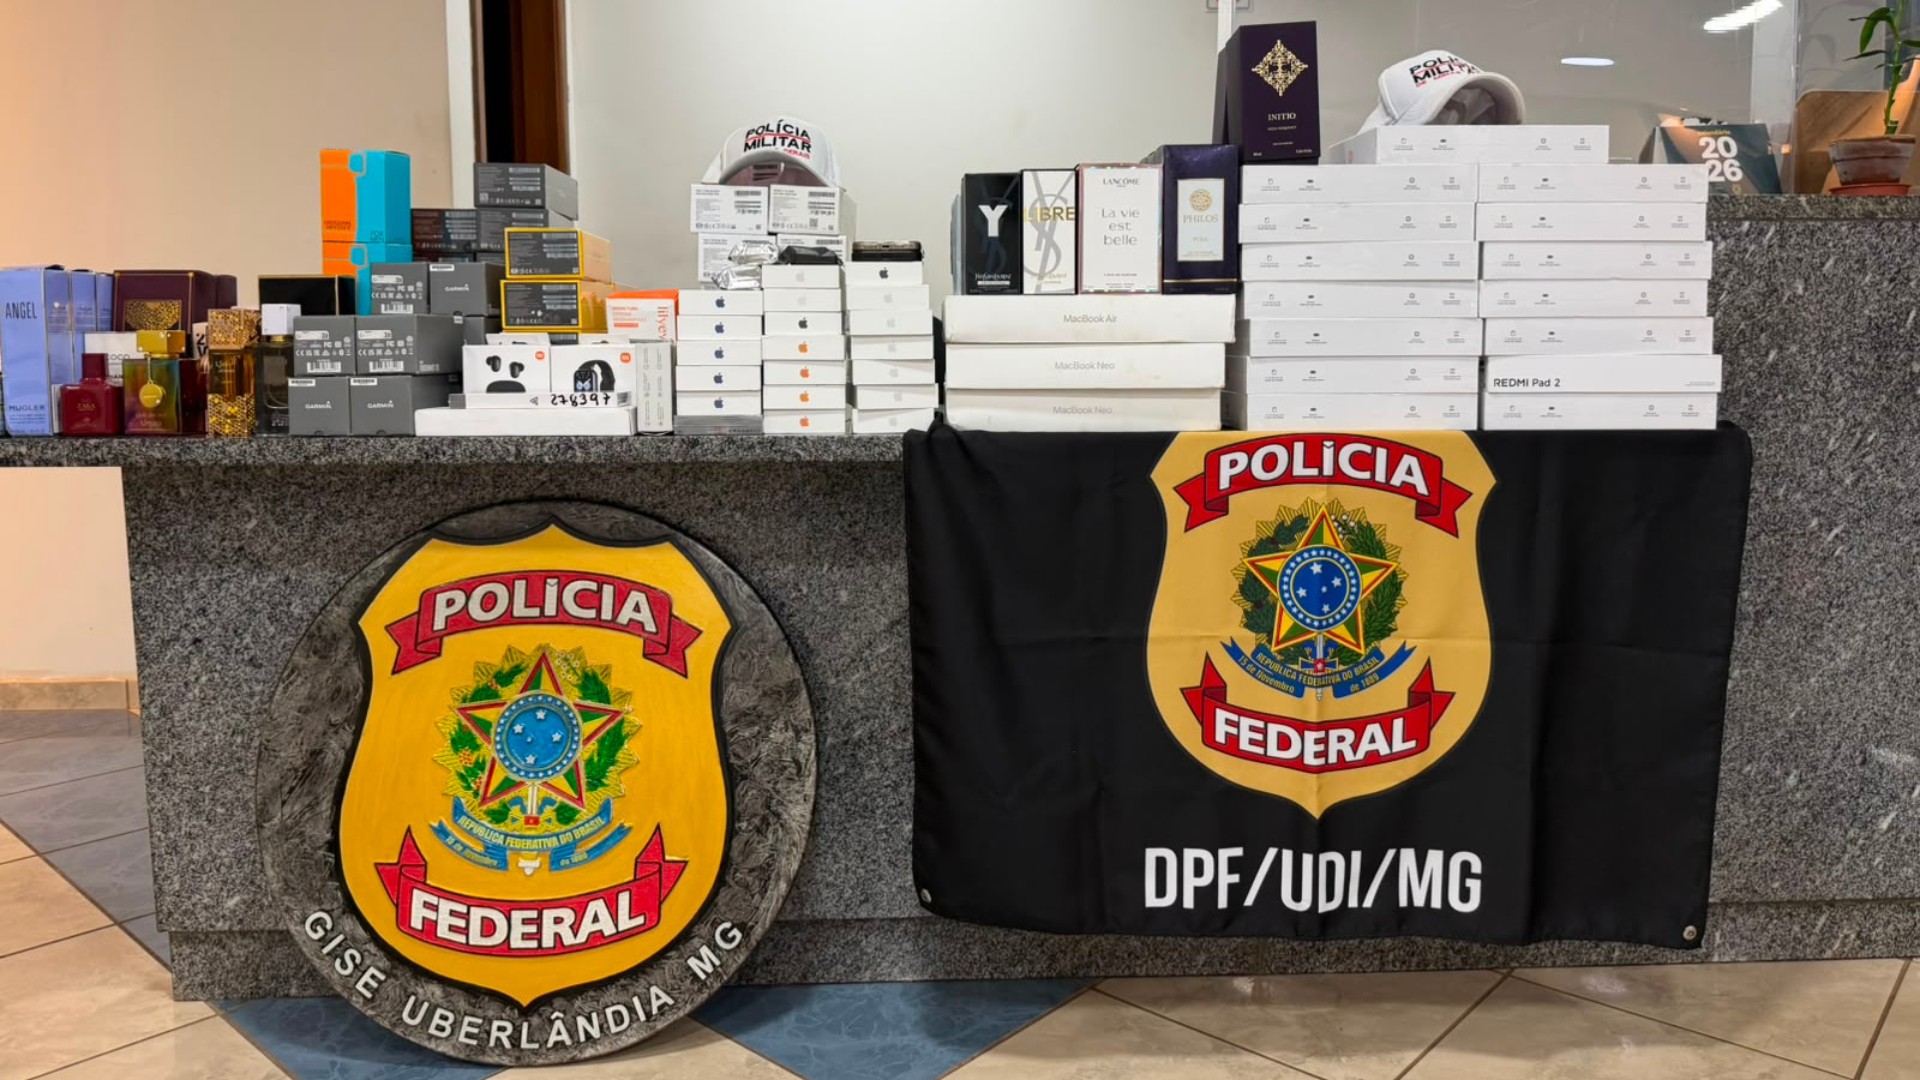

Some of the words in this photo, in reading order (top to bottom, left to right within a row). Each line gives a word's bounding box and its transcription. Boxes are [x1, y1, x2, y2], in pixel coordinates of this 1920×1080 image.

[1268, 112, 1297, 121] INITIO
[744, 119, 811, 140] POLÍCIA
[743, 136, 812, 153] MILITAR
[1699, 136, 1738, 159] 20
[1706, 158, 1743, 182] 26
[1103, 177, 1140, 186] LANCÔME
[978, 204, 1009, 237] Y
[1023, 206, 1076, 222] LIBRE
[1101, 208, 1117, 219] La
[1120, 208, 1141, 219] vie
[1183, 214, 1220, 224] PHILOS
[1108, 222, 1132, 231] est
[1103, 234, 1138, 246] belle
[5, 301, 38, 320] ANGEL
[1063, 313, 1104, 323] MacBook
[1105, 314, 1119, 323] Air
[1054, 360, 1095, 370] MacBook
[1096, 361, 1116, 370] Neo
[1492, 378, 1530, 388] REDMI
[1531, 377, 1551, 388] Pad
[1554, 378, 1561, 388] 2
[550, 392, 612, 407] 278397
[1052, 406, 1093, 415] MacBook
[1094, 406, 1113, 415] Neo
[1218, 440, 1430, 497] POLÍCIA
[432, 577, 658, 634] POLÍCIA
[1238, 655, 1247, 666] 15
[1246, 663, 1256, 674] de
[1298, 673, 1341, 686] FEDERATIVA
[1342, 671, 1352, 681] DO
[1354, 656, 1380, 676] BRASIL
[1349, 682, 1360, 693] de
[1214, 707, 1417, 766] FEDERAL
[572, 815, 605, 839] BRASIL
[1144, 846, 1483, 914] DPF/UDI/MG
[409, 887, 646, 950] FEDERAL
[303, 910, 387, 999] GISE
[401, 984, 677, 1050] UBERLÂNDIA
[686, 920, 744, 982] MG
